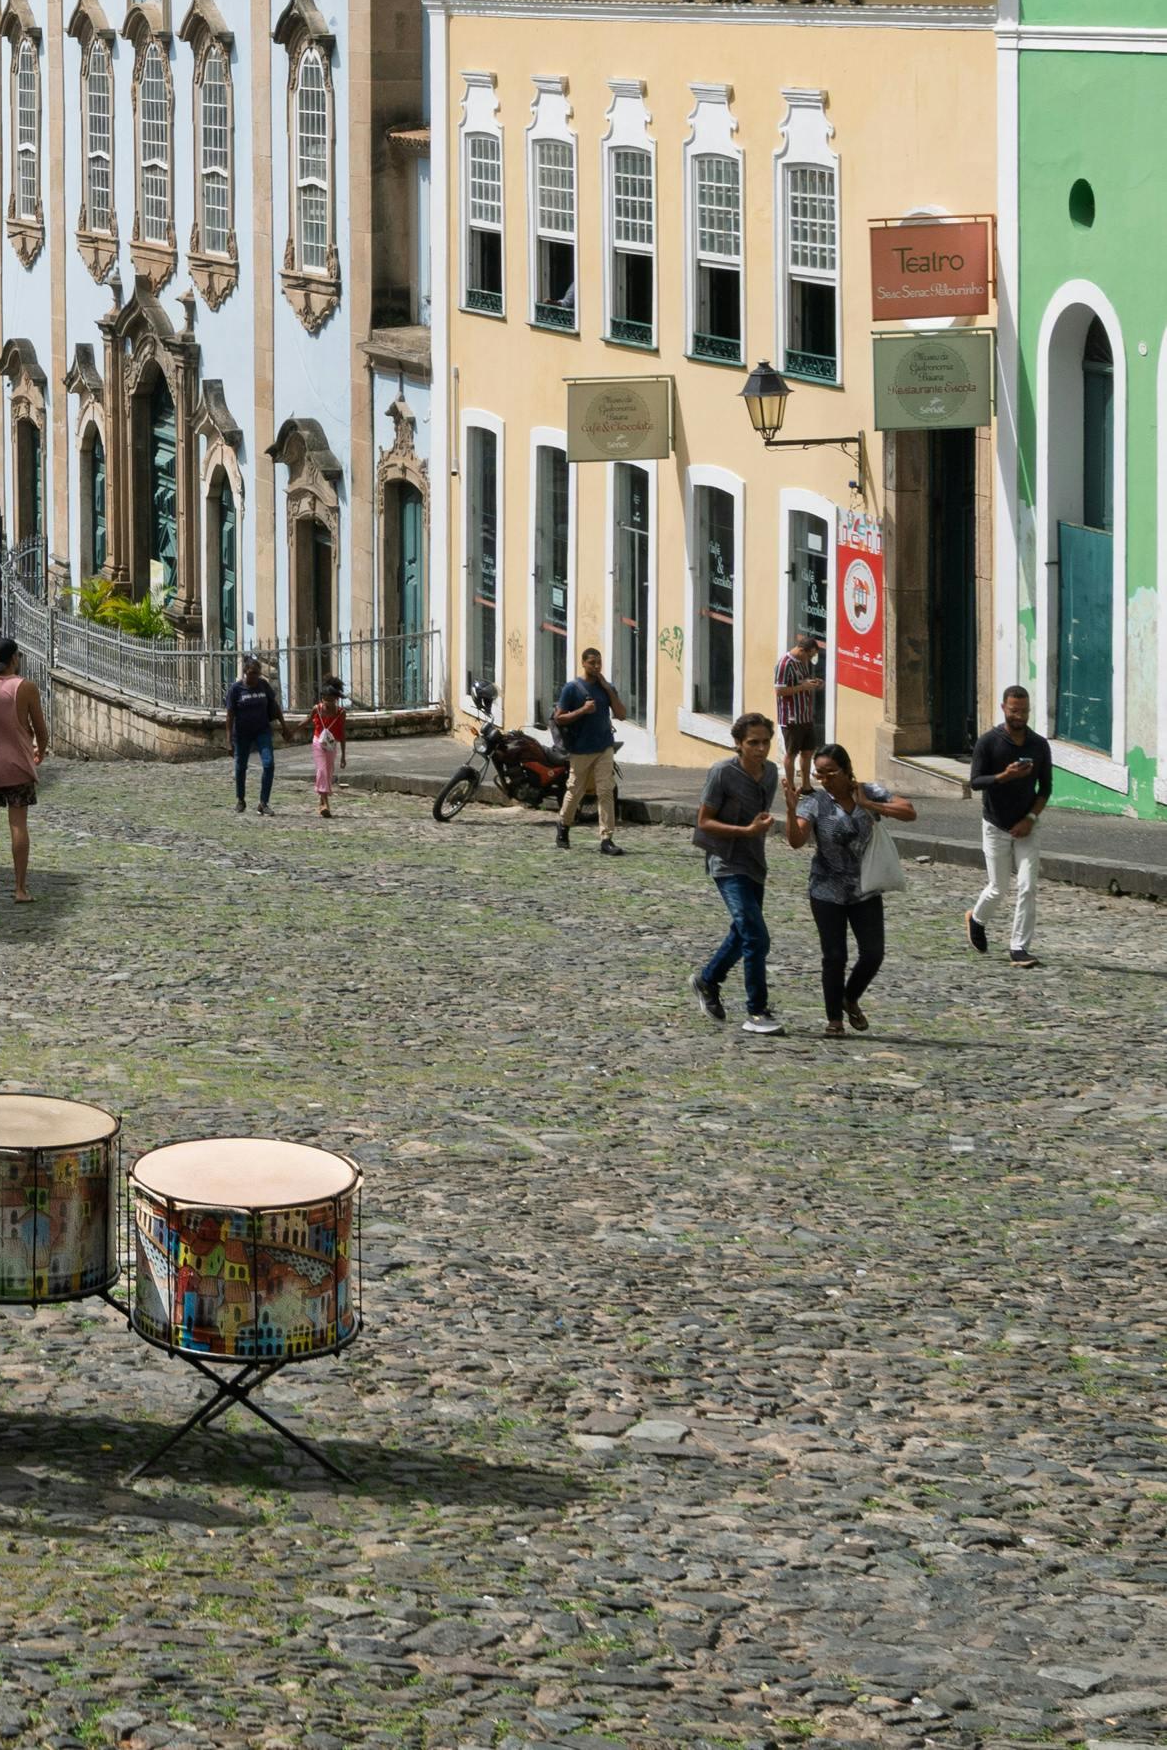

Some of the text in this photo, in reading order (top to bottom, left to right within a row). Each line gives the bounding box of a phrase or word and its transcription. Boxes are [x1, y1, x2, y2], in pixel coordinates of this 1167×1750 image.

[892, 247, 964, 274] Teatro
[901, 284, 930, 298] Senac
[930, 282, 984, 297] Pelourinho
[887, 381, 978, 395] Restaurante Escola
[811, 583, 818, 603] &
